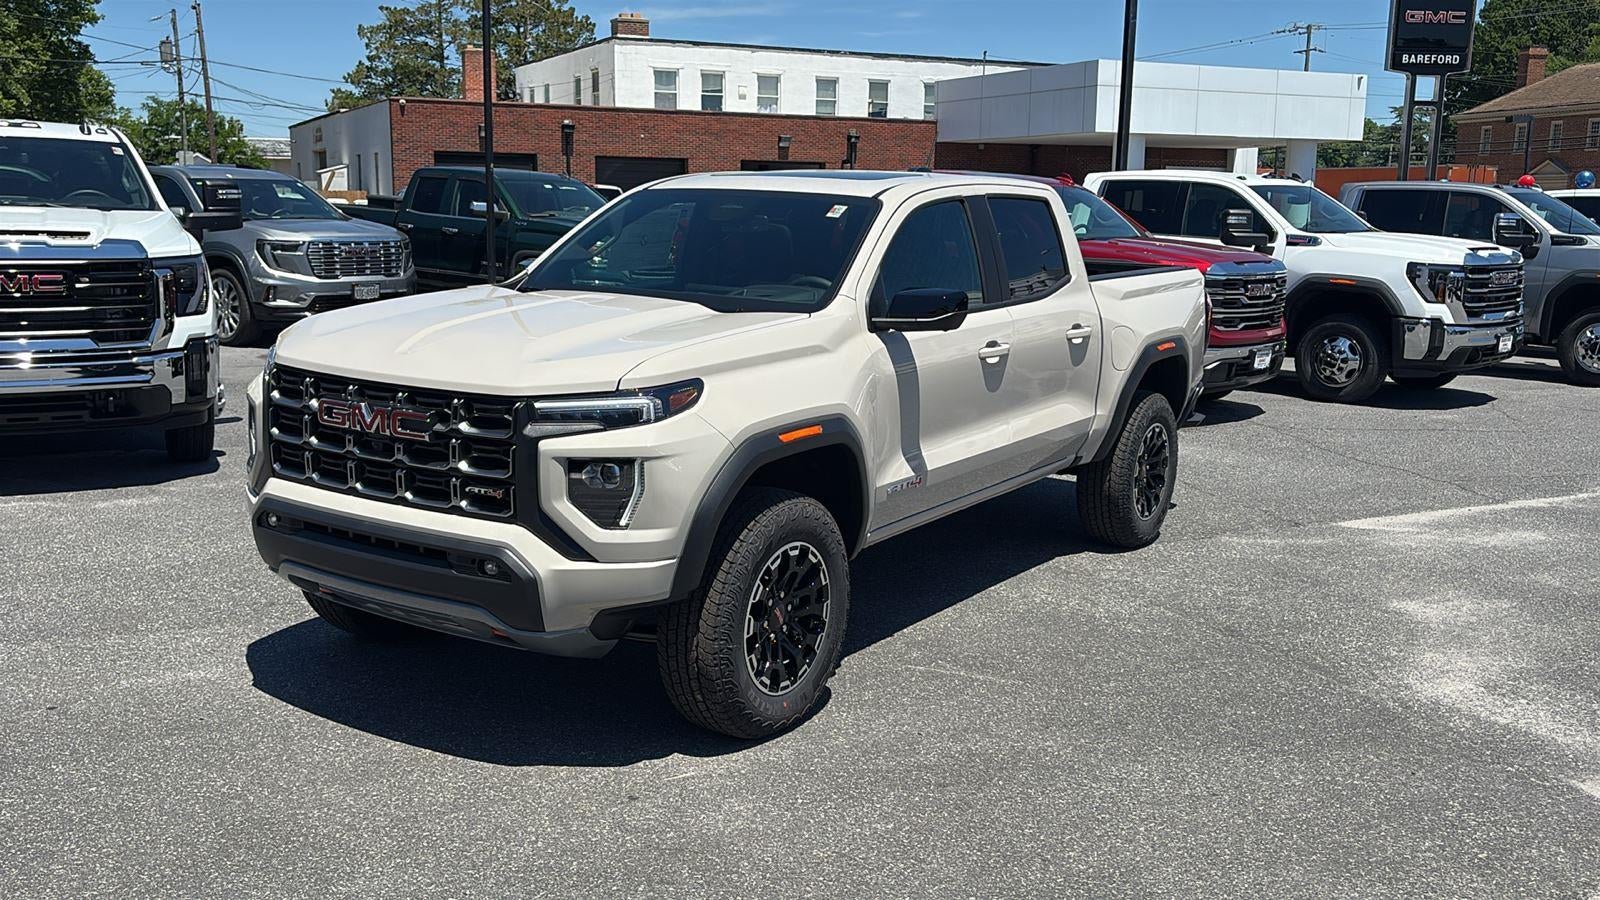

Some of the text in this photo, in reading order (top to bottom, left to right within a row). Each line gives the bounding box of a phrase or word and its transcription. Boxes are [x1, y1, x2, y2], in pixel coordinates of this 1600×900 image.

[1405, 10, 1466, 23] GMC
[1402, 54, 1460, 64] BAREFORD
[0, 274, 64, 291] MC
[318, 399, 430, 441] GMC
